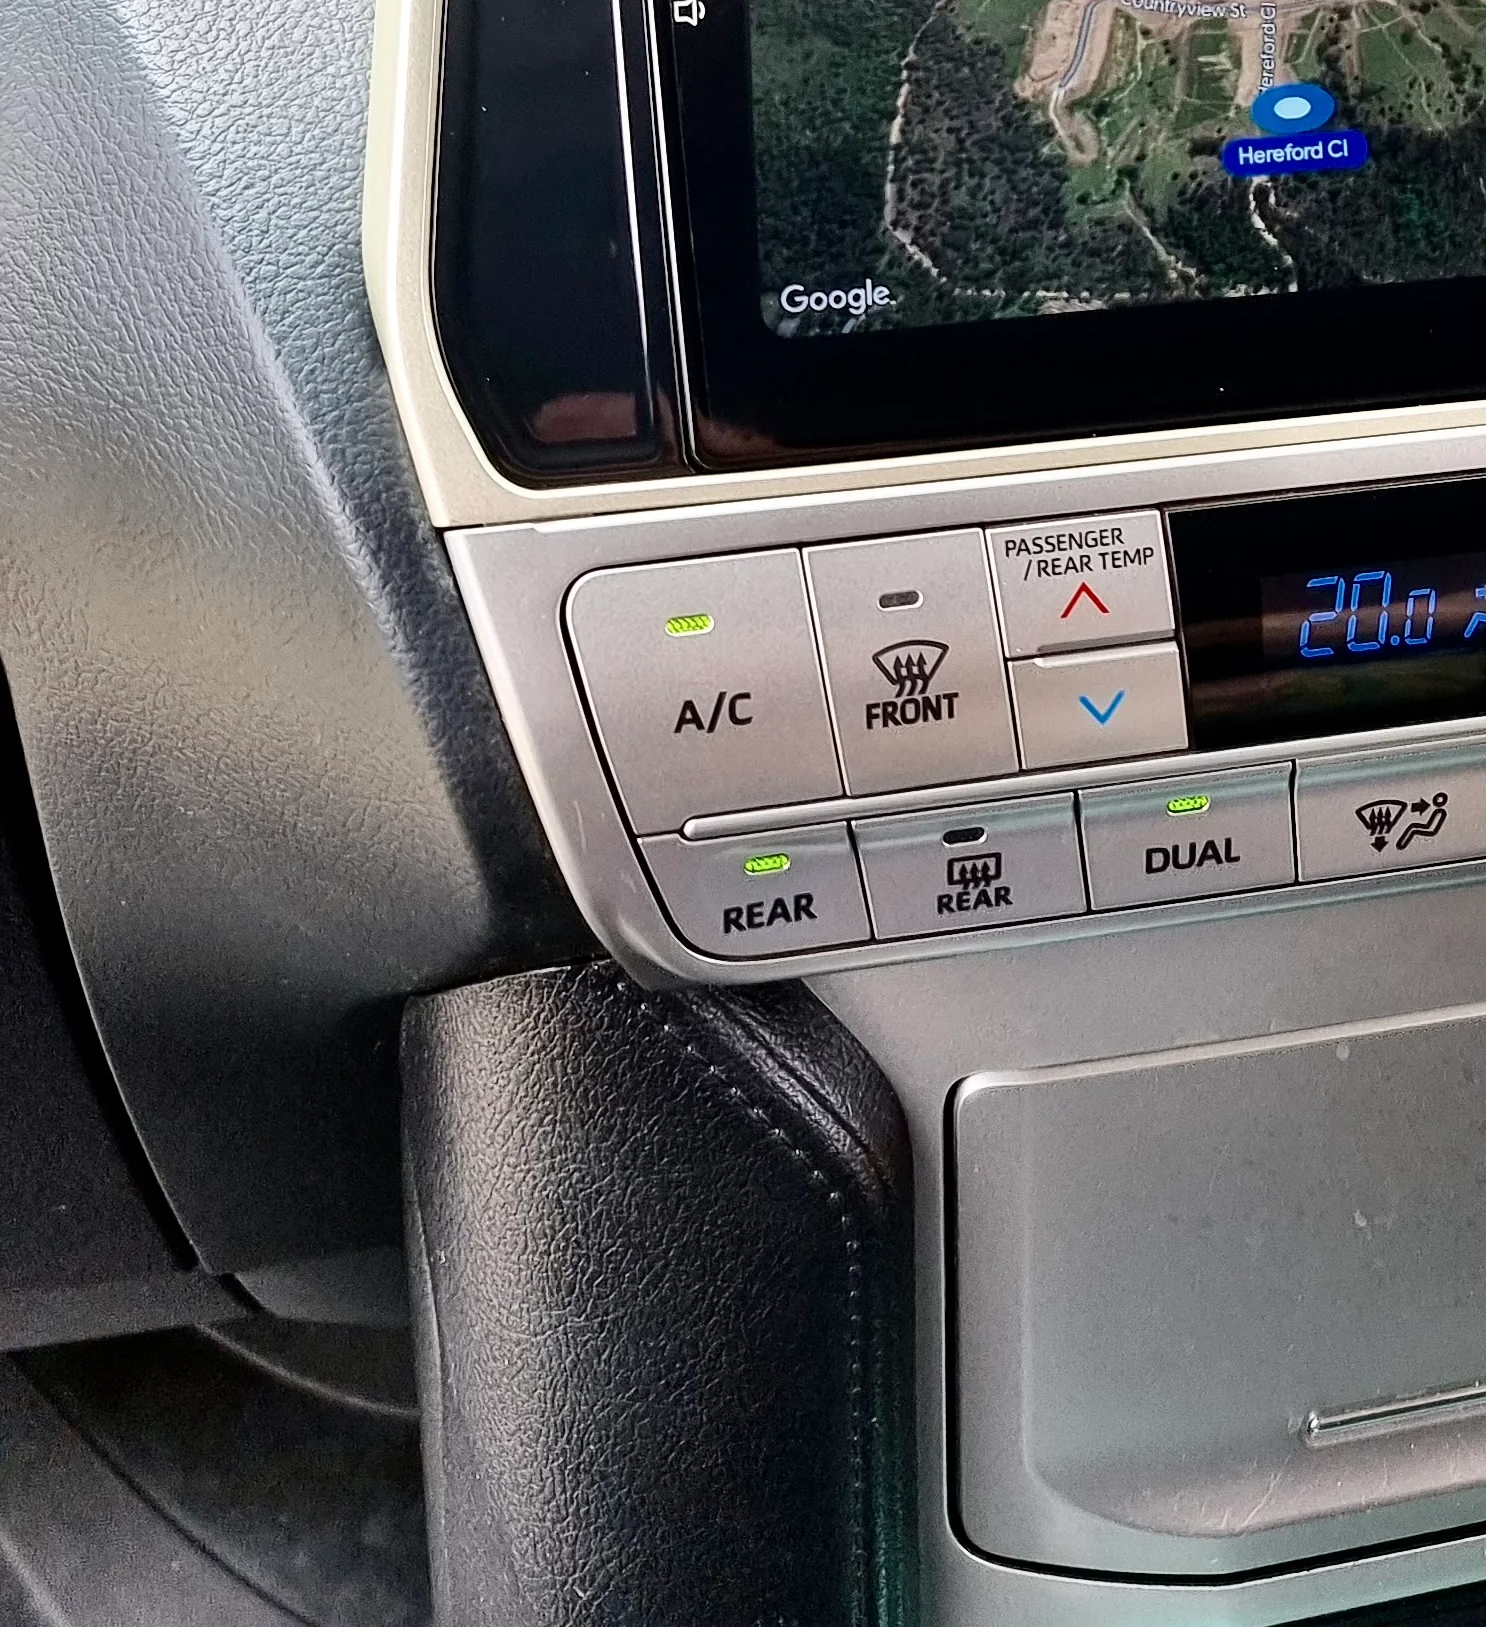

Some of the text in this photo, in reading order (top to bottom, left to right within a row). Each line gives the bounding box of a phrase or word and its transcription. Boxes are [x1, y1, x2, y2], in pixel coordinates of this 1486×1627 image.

[1229, 2, 1248, 19] St
[1238, 138, 1350, 166] Hereford Cl
[780, 278, 893, 315] Google
[1004, 527, 1125, 558] PASSENGER
[1097, 546, 1155, 571] TEMP
[1300, 569, 1437, 658] 20.0
[673, 691, 754, 735] A/C
[865, 691, 960, 730] FRONT
[1144, 838, 1242, 875] DUAL
[721, 892, 818, 934] REAR
[936, 885, 1014, 916] REAR
